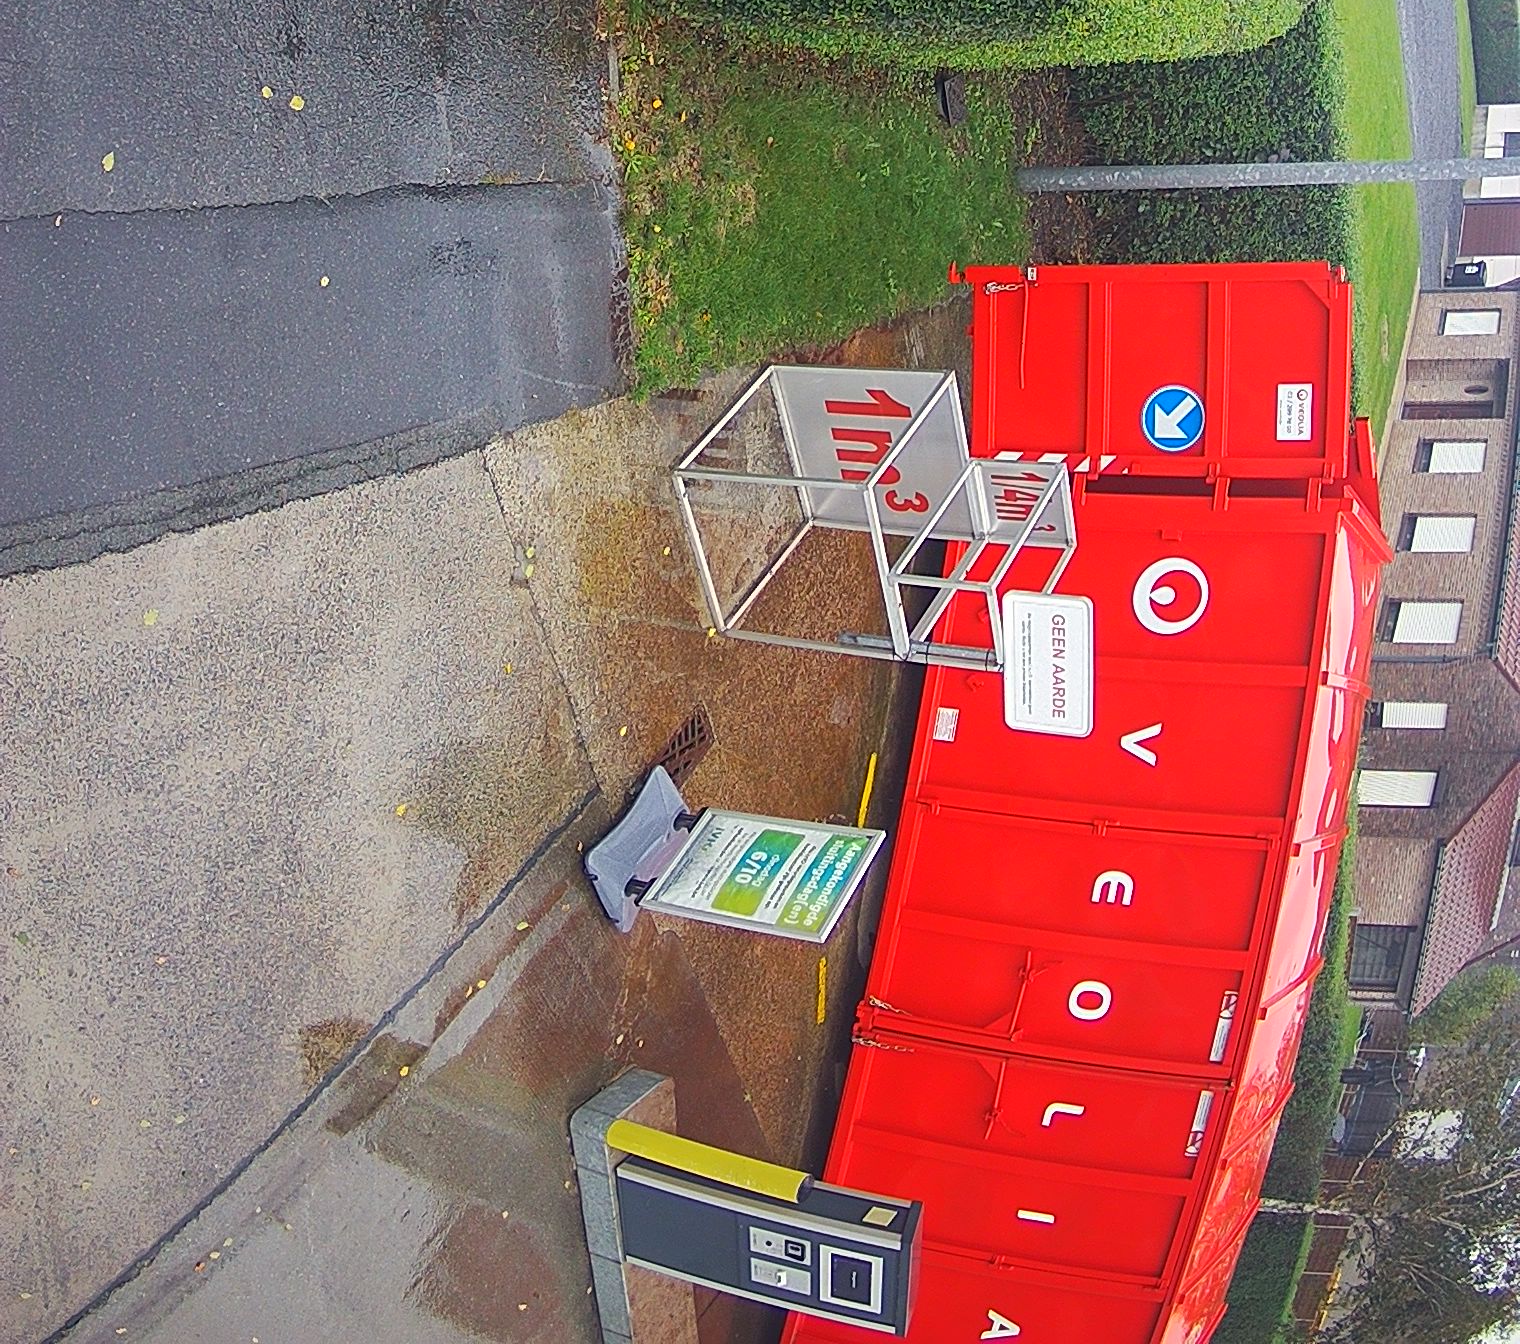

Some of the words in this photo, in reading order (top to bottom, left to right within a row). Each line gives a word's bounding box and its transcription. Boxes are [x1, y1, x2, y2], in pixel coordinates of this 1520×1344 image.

[1051, 614, 1066, 659] GEEN
[1051, 663, 1066, 719] AARDE
[734, 851, 768, 884] 6/10
[783, 840, 845, 925] sluitingsdag(en)
[803, 842, 862, 926] Aangekondigde
